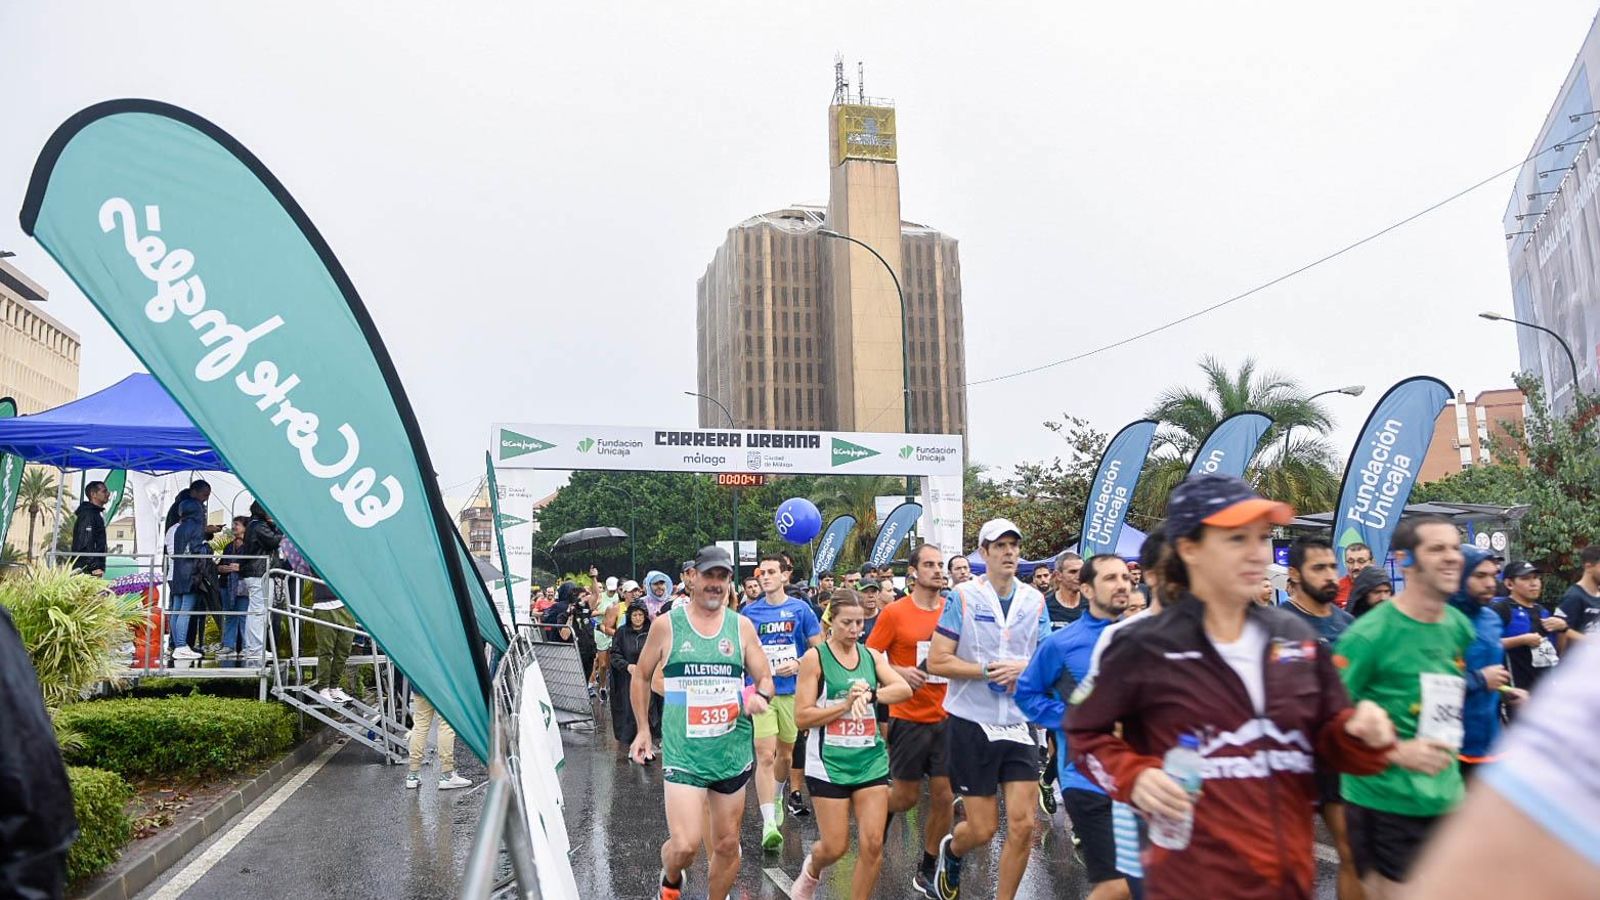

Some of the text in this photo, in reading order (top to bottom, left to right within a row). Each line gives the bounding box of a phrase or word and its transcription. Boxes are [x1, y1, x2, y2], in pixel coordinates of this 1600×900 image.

[597, 438, 644, 448] Fundación
[655, 431, 821, 449] CARRERA URBANA
[597, 447, 631, 457] Unicaja
[916, 446, 957, 455] Fundación
[683, 452, 726, 466] málaga
[916, 454, 946, 463] Unicaja
[1346, 419, 1403, 525] Fundación
[719, 474, 764, 485] 00:00:41
[1365, 454, 1412, 529] Unicaja
[1086, 459, 1122, 542] Fundación
[1097, 486, 1128, 545] Unicaja
[873, 521, 899, 566] undación
[1493, 535, 1505, 547] 35
[815, 532, 836, 571] undación
[760, 621, 793, 635] ROMA
[684, 663, 732, 675] ATLETISMO
[700, 707, 729, 725] 339
[838, 722, 866, 736] 129
